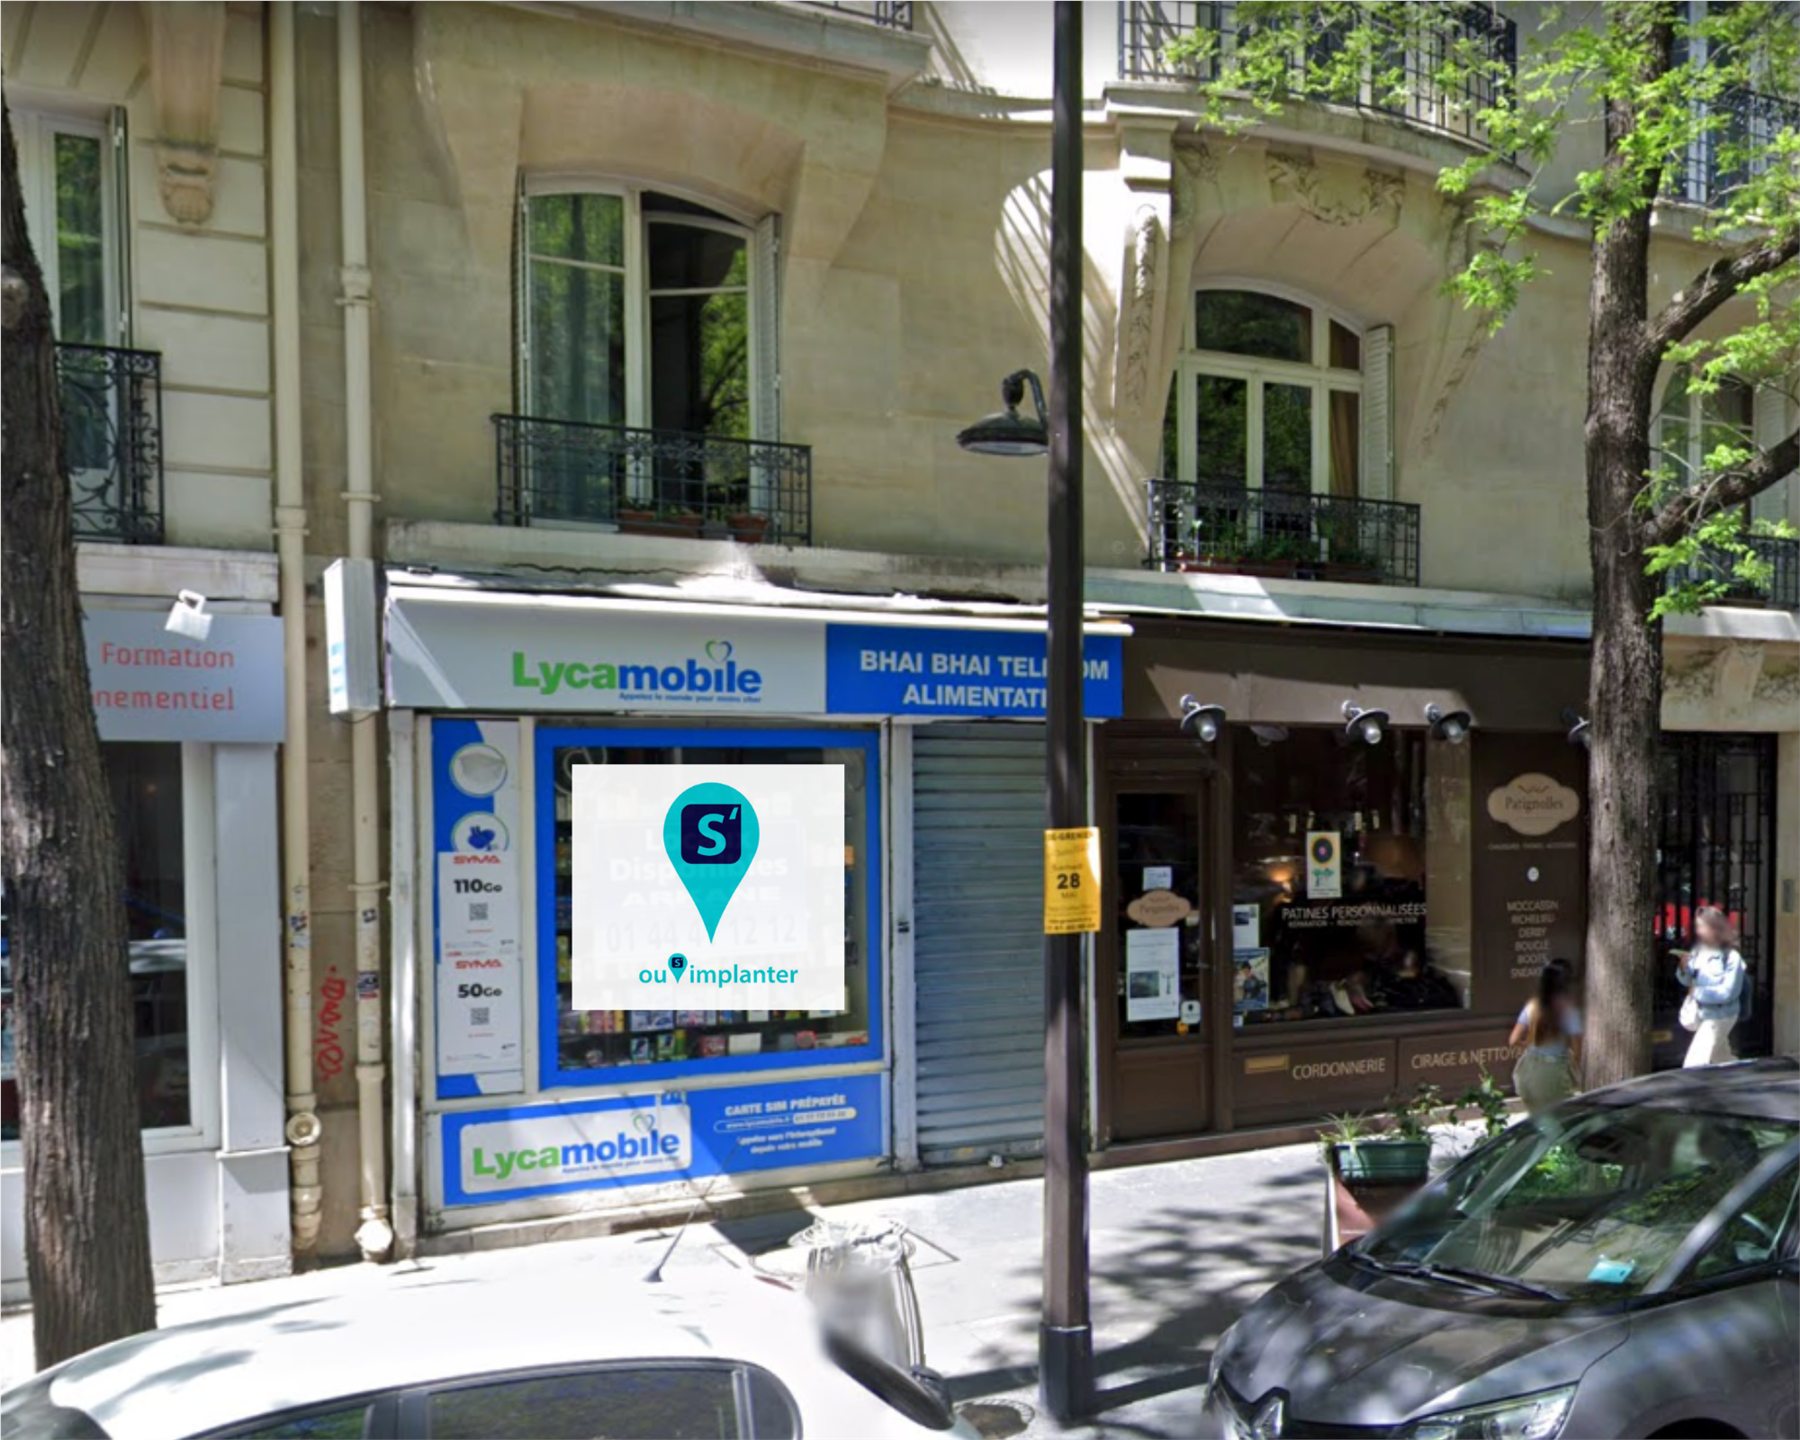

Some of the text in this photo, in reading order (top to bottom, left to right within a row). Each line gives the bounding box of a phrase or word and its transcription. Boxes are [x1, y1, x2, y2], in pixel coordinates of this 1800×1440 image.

[101, 642, 235, 668] Formation
[860, 649, 923, 673] BHAI
[931, 653, 990, 676] BHAI
[512, 651, 763, 695] Lycamobile
[1056, 872, 1081, 890] 28
[1281, 902, 1427, 920] PATINES PERSONNALISÉES
[1292, 1057, 1387, 1081] CORDONNERIE
[1411, 1052, 1457, 1070] CIRAGE
[1459, 1051, 1468, 1065] &
[724, 1102, 763, 1117] CARTE
[473, 1126, 680, 1181] Lycamobile
